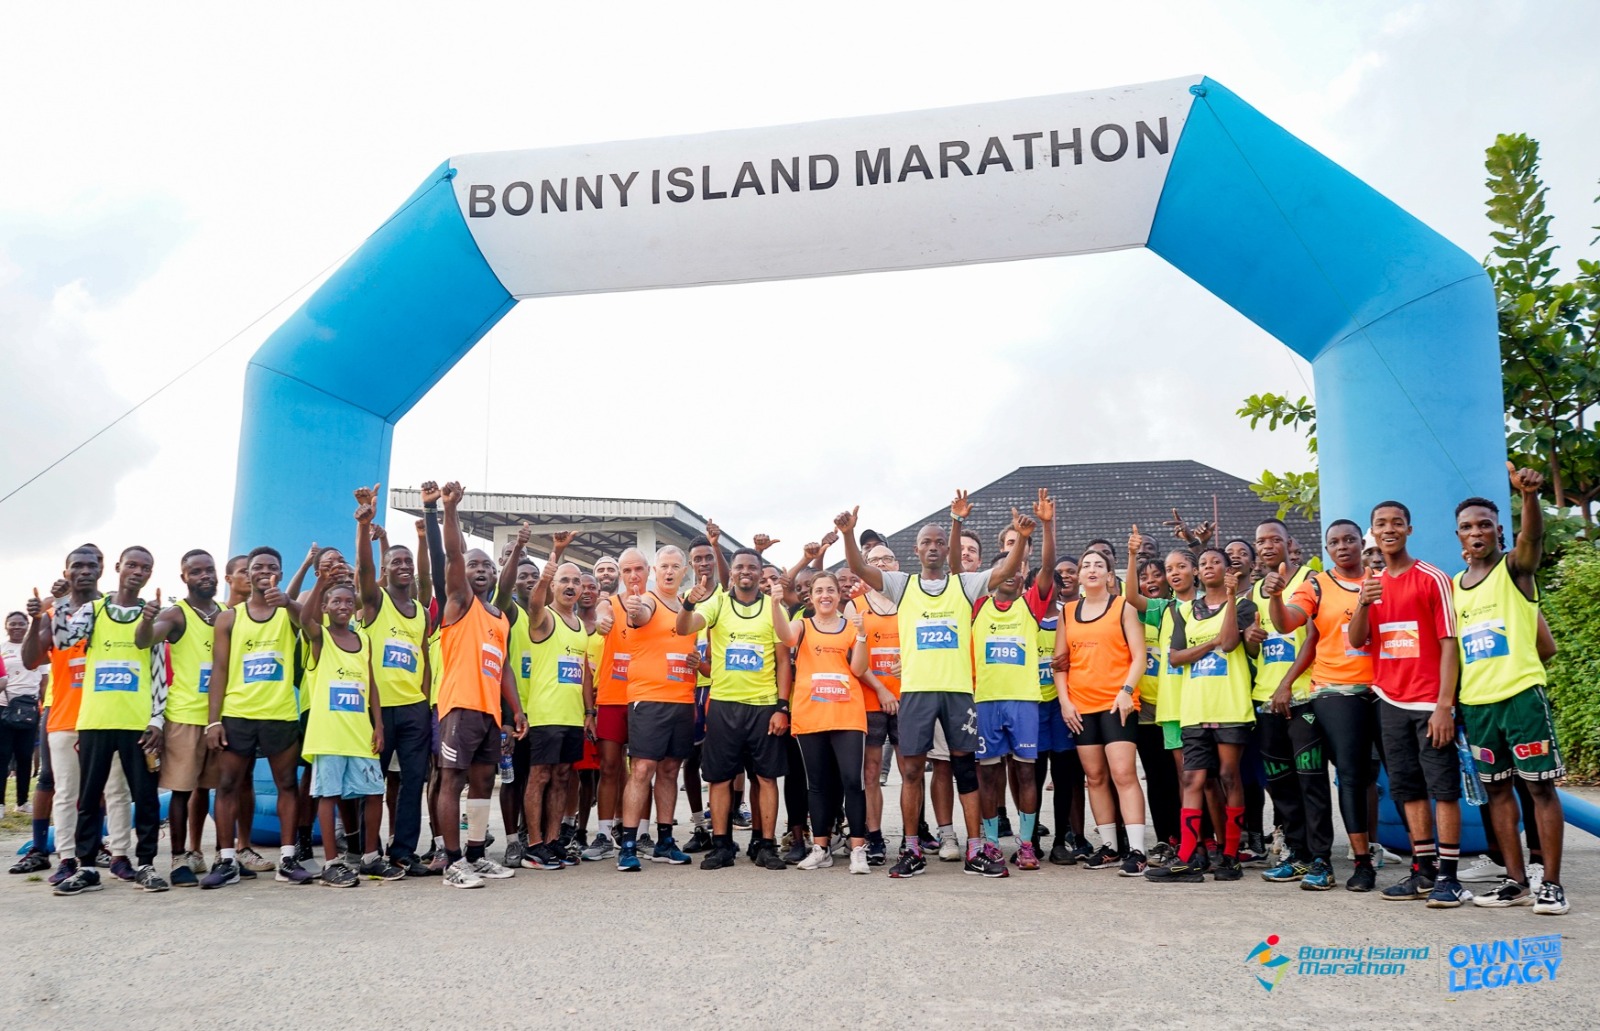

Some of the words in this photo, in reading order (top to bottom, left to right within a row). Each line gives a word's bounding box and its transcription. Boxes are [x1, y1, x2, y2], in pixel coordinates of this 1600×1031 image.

[468, 171, 639, 218] BONNY
[651, 154, 840, 205] ISLAND
[855, 117, 1169, 187] MARATHON
[921, 631, 952, 643] 7224
[1384, 639, 1415, 648] LEISURE
[389, 650, 411, 665] 7131
[989, 647, 1018, 658] 7196
[729, 654, 757, 666] 7144
[247, 663, 277, 677] 7227
[561, 667, 582, 678] 7230
[98, 673, 132, 685] 7229
[815, 686, 846, 695] LEISURE
[338, 693, 360, 705] 7111
